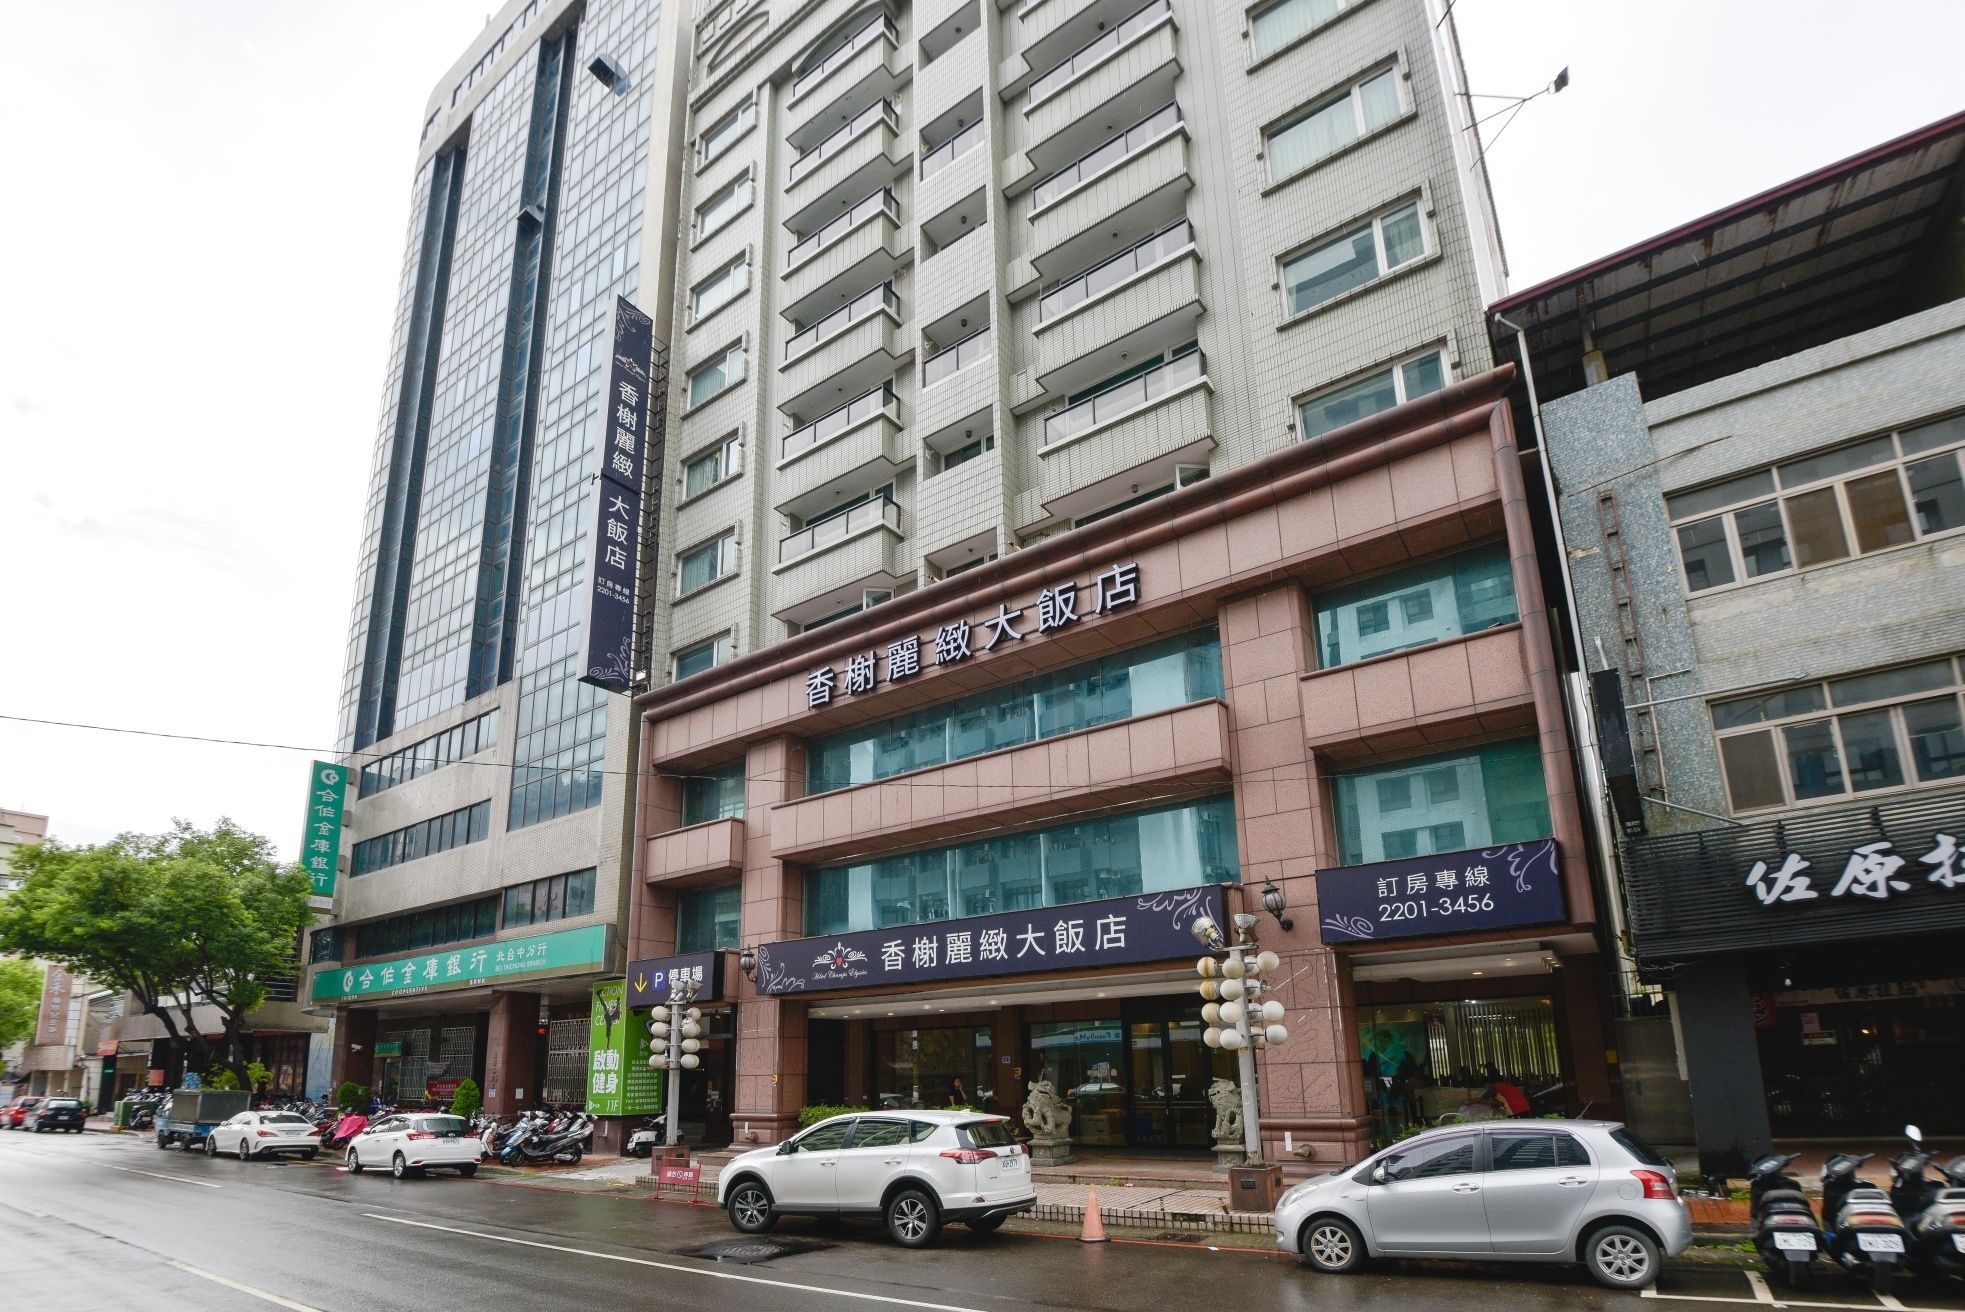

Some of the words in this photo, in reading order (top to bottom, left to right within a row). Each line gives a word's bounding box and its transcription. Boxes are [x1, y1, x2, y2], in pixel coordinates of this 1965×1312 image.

[597, 586, 630, 604] 2201-3456
[804, 562, 1141, 709] 香榭麗緻大飯店
[1377, 865, 1491, 898] 訂房專線
[1378, 893, 1495, 922] 2201-3456
[880, 914, 1127, 972] 香榭麗緻大飯店
[359, 949, 488, 990] 合作金庫銀行
[654, 972, 664, 989] P
